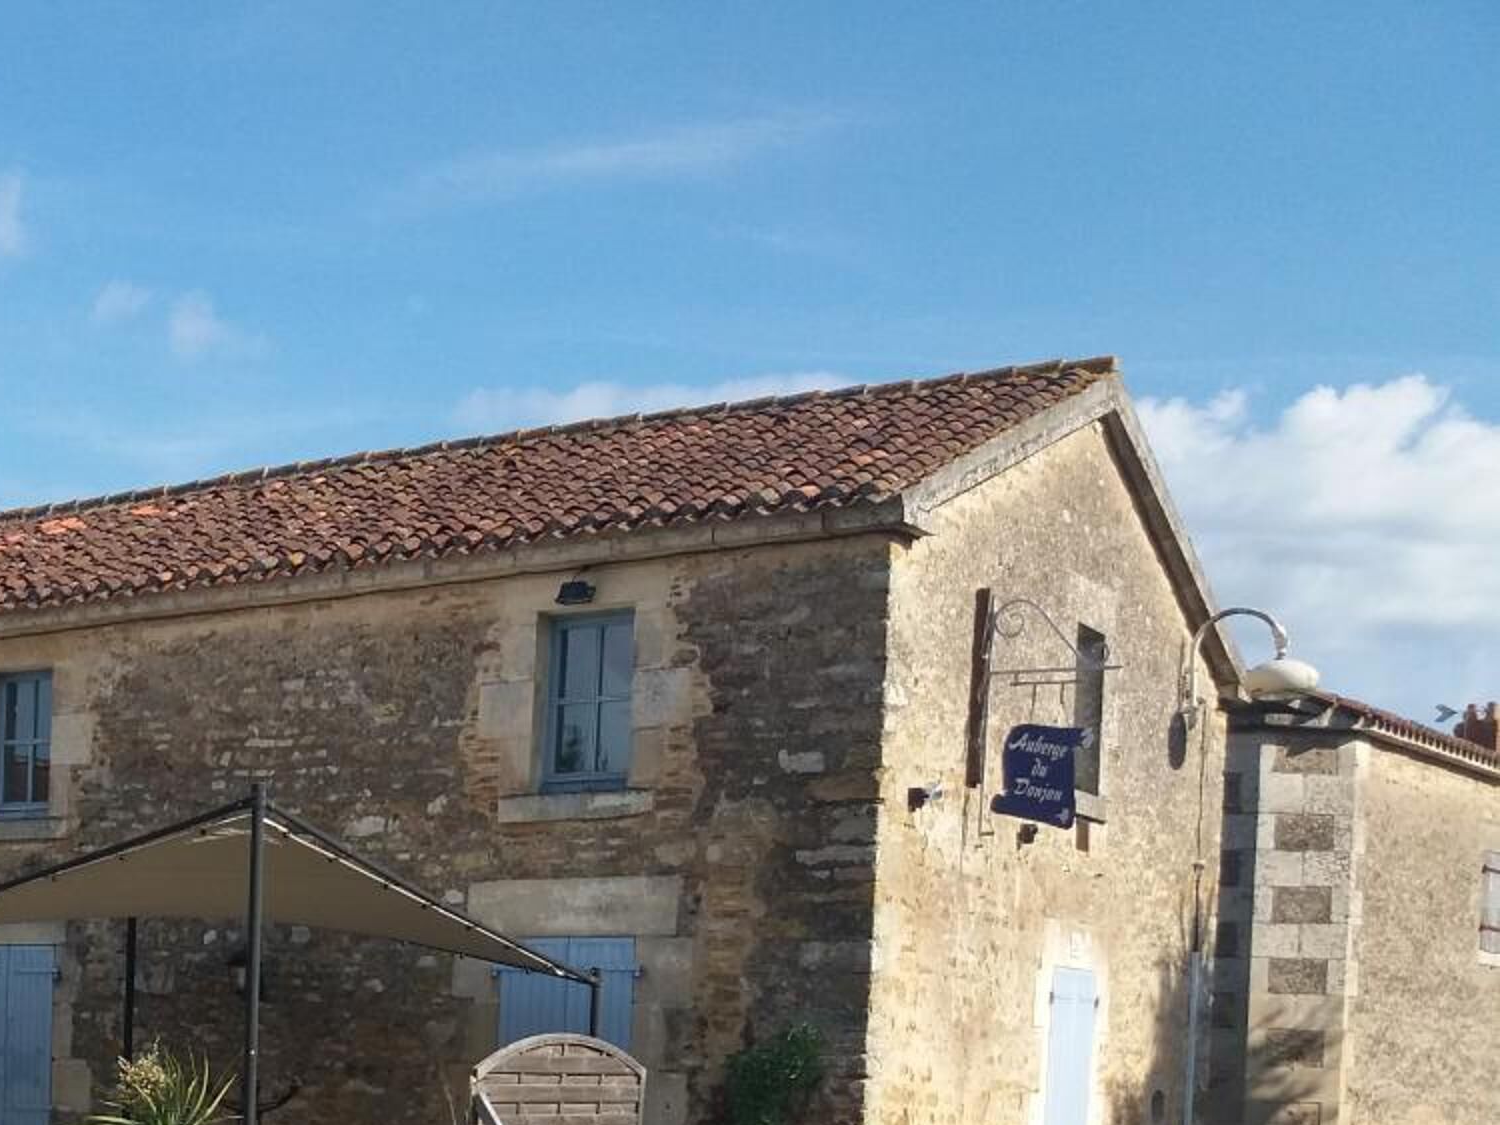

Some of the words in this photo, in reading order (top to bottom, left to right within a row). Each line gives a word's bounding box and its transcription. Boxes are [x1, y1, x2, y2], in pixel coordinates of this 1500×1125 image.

[1008, 732, 1068, 761] Auberge
[1031, 757, 1047, 777] du
[1014, 778, 1062, 803] Donjon
